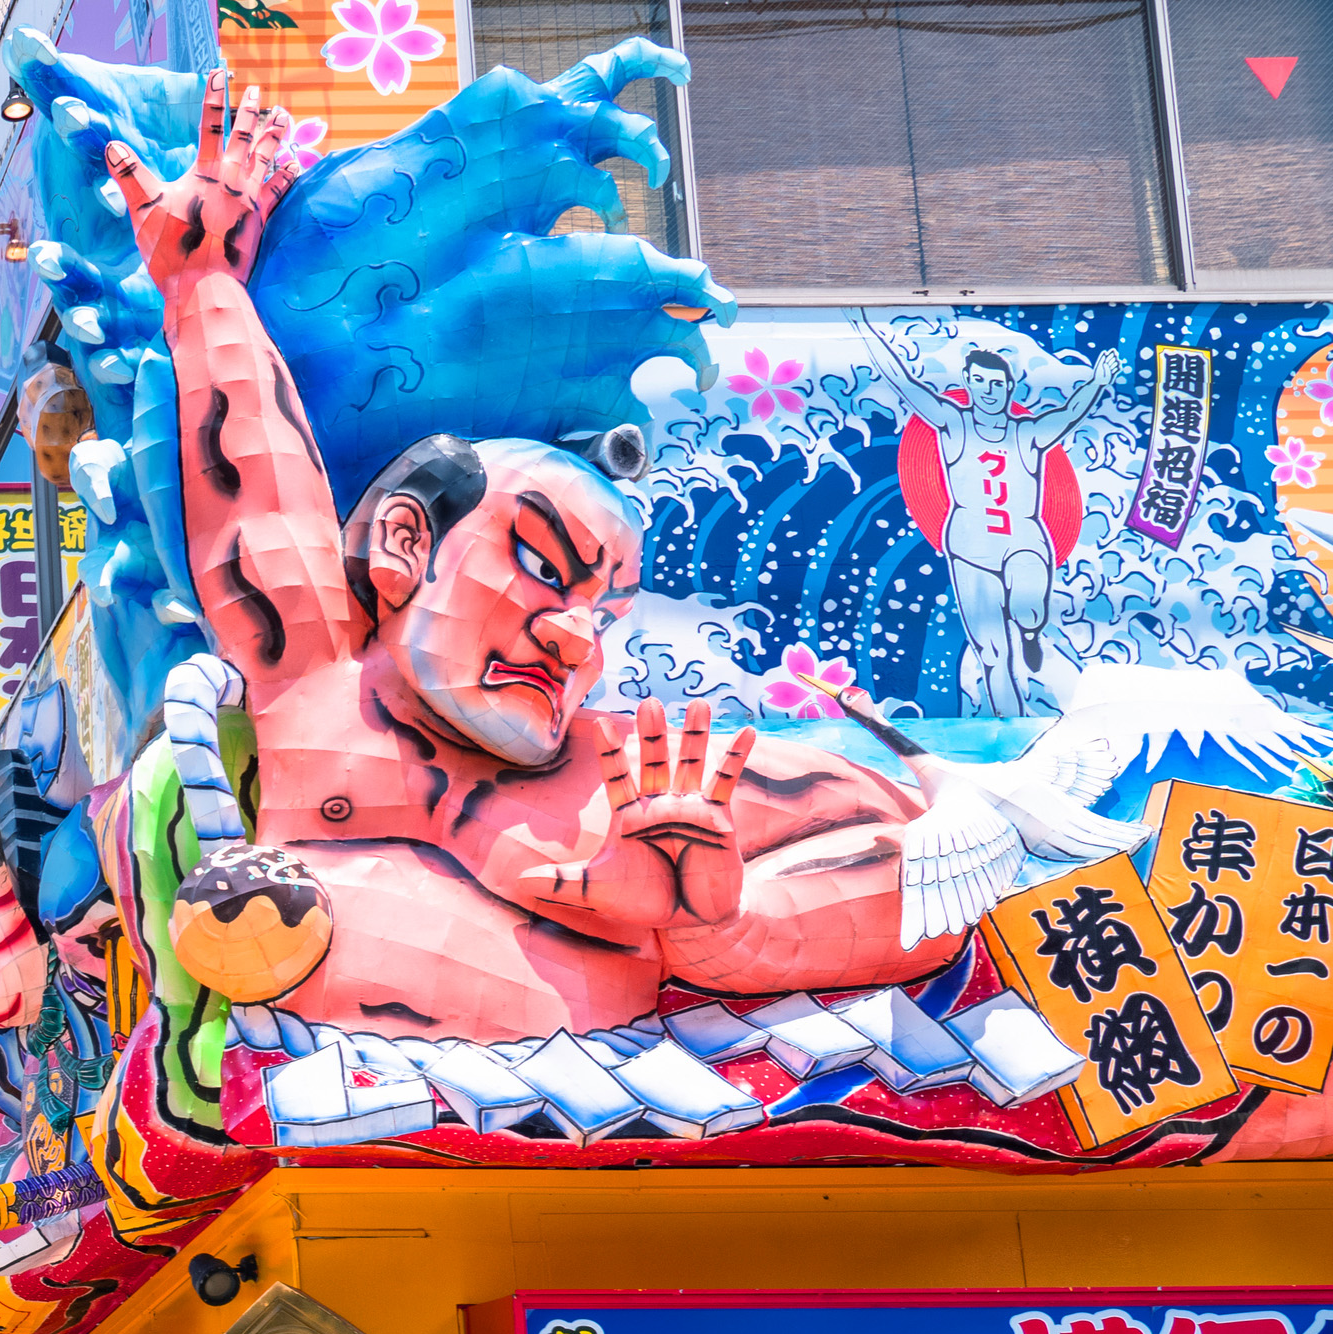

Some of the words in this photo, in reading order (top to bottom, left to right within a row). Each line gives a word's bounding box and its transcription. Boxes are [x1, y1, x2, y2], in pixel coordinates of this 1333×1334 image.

[977, 449, 1012, 537] グリコ
[1141, 355, 1206, 530] 開運招福
[1030, 886, 1203, 1114] 横綱
